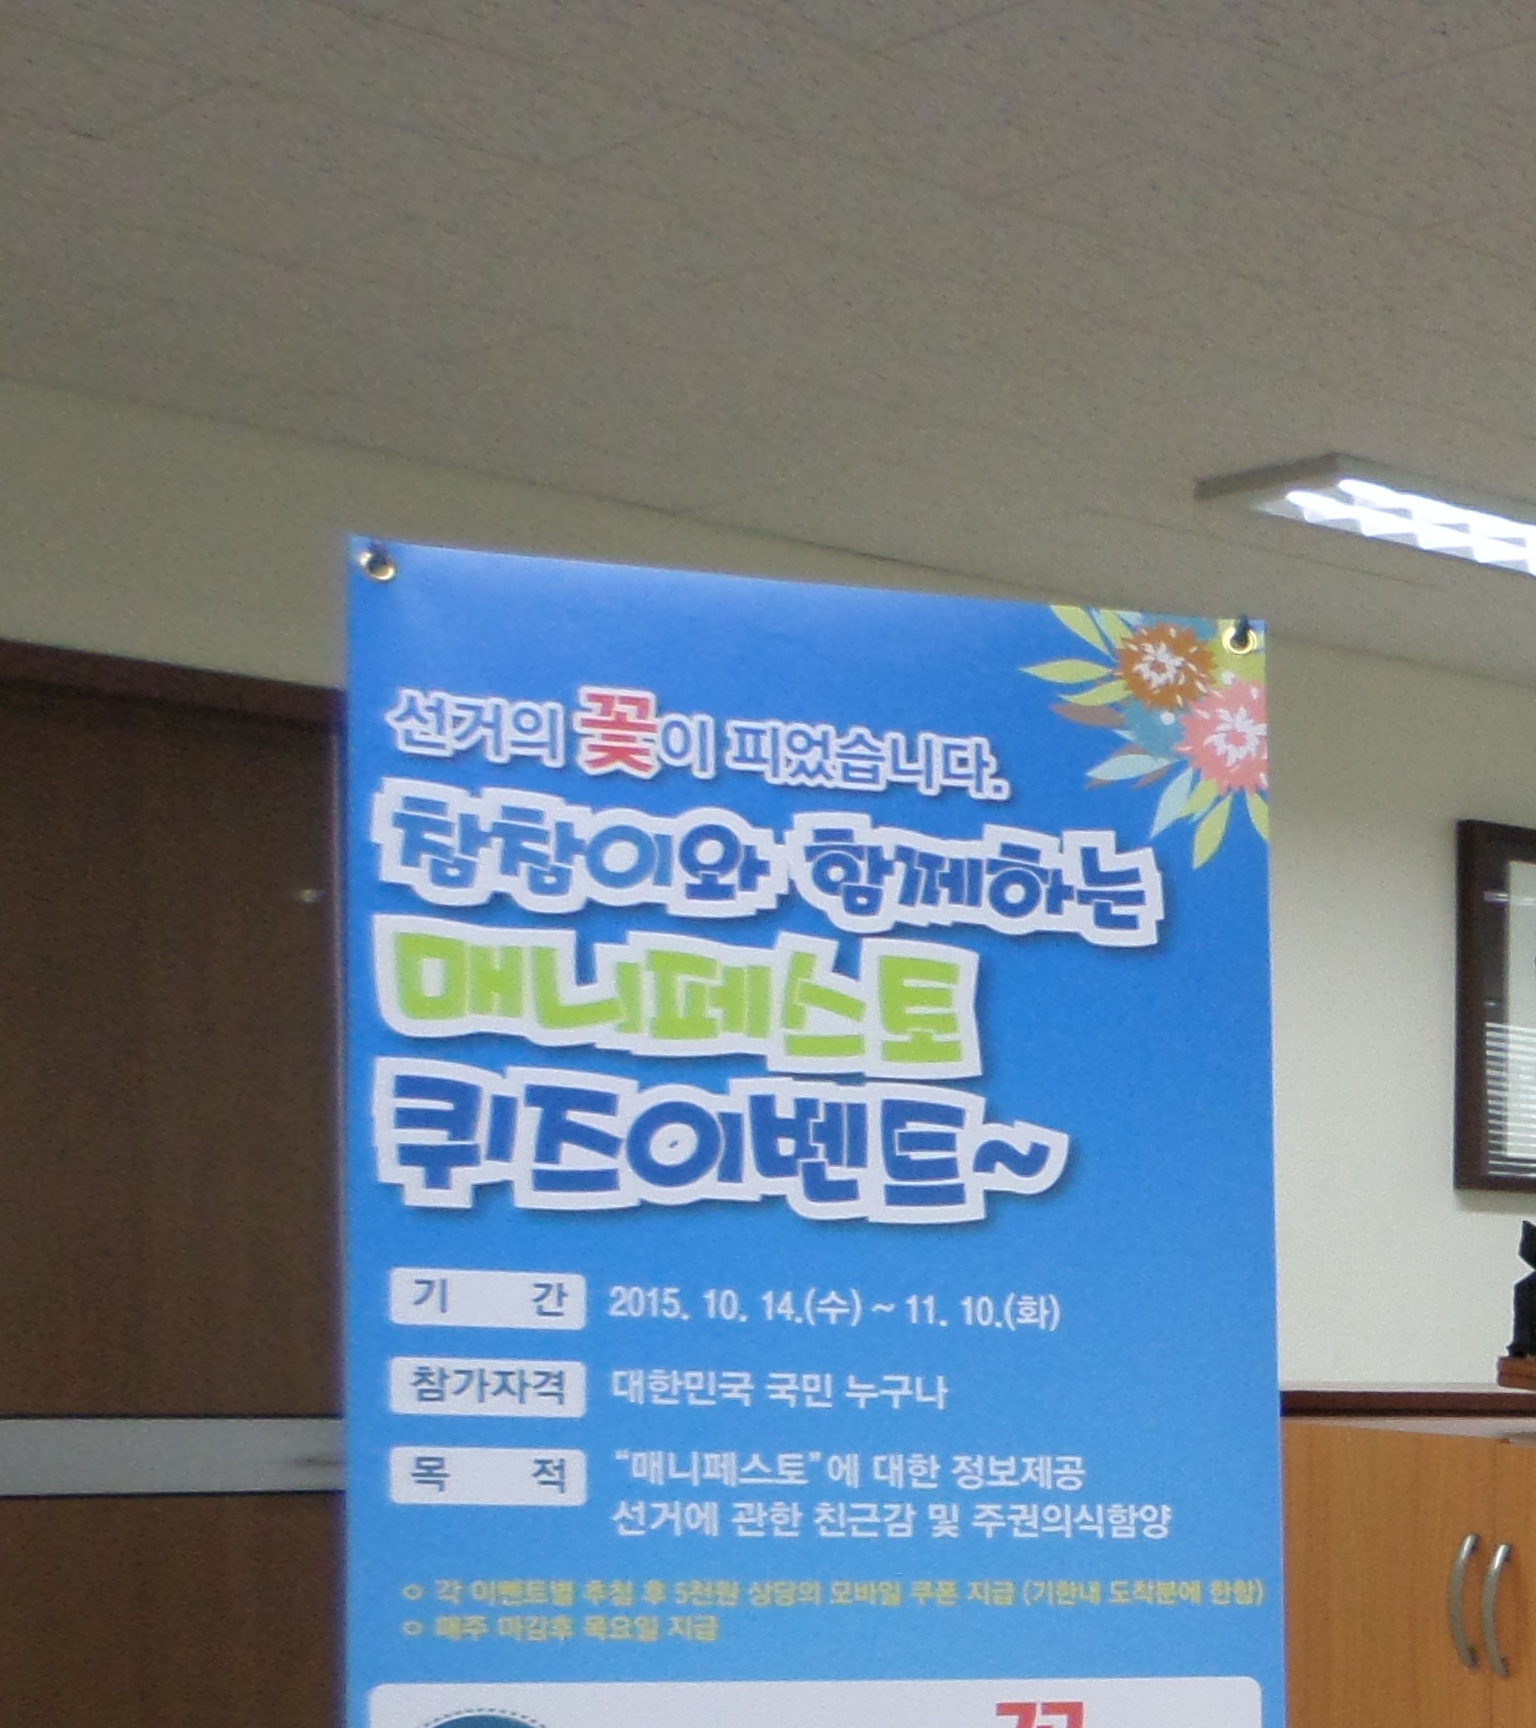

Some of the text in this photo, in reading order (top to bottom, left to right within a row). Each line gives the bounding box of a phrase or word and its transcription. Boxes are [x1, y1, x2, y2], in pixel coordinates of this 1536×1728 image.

[391, 685, 1009, 799] 선거의 꽃이 피었습니다.
[799, 822, 1156, 937] 함께하는
[385, 925, 974, 1069] 매니페스토
[608, 1286, 690, 1323] 2015.
[704, 1288, 747, 1324] 10.
[761, 1287, 862, 1329] 14.(수)
[906, 1293, 946, 1329] 11.
[961, 1292, 1062, 1332] 10.(화)
[411, 1364, 566, 1406] 참가자격
[611, 1370, 948, 1412] 대한민국 국민 누구나
[873, 1452, 940, 1490] 대한
[951, 1454, 1086, 1492] 정보제공
[612, 1500, 1172, 1542] 선거에 관한 친근감 및 주권의식함양
[830, 1579, 900, 1606] 모바일
[911, 1579, 958, 1605] 쿠폰
[967, 1579, 1016, 1606] 지급
[667, 1615, 718, 1642] 지급
